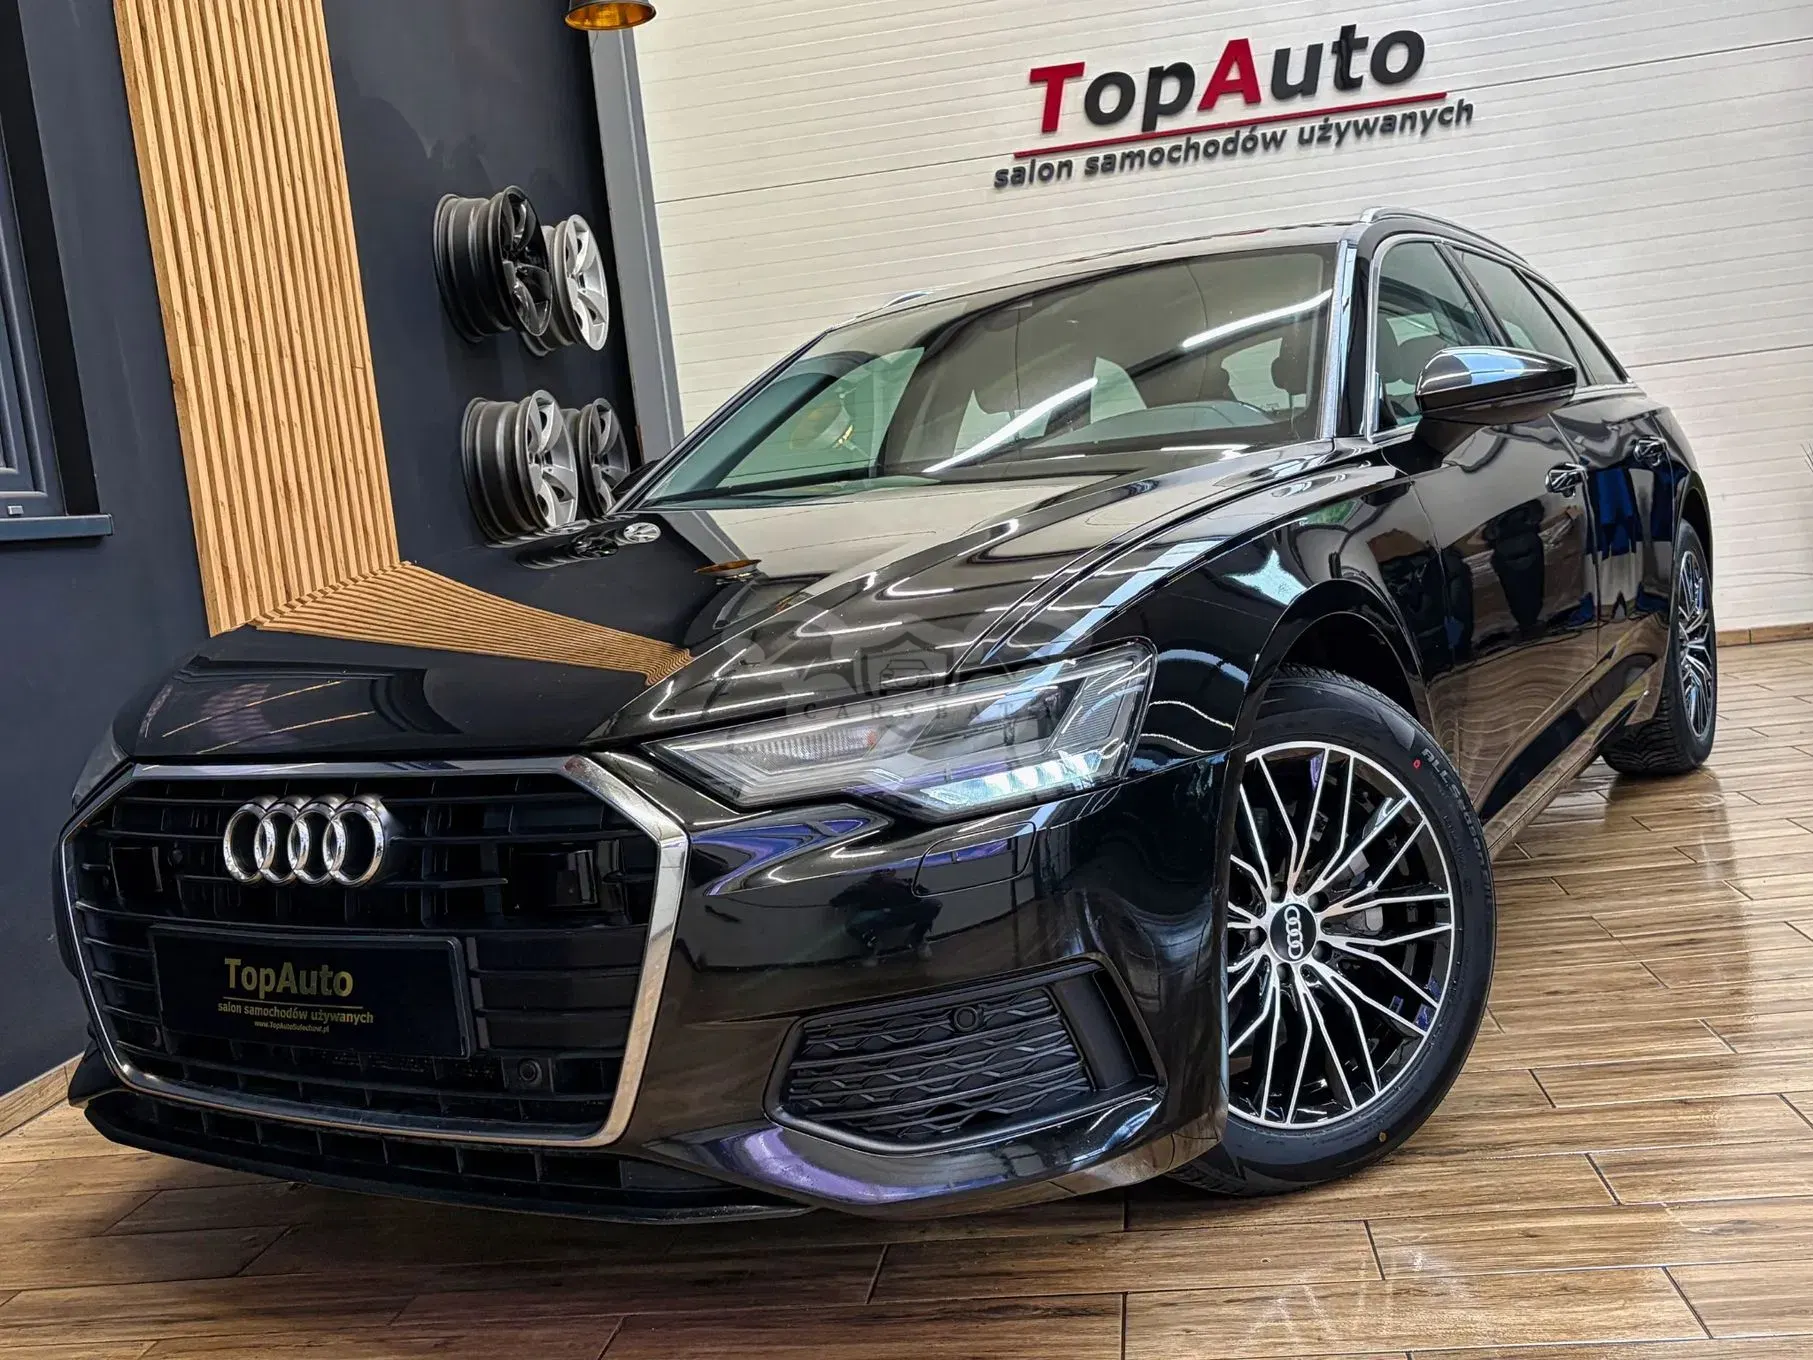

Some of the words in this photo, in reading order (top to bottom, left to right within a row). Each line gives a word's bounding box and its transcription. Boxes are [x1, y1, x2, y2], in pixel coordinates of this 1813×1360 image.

[1029, 24, 1425, 134] TopAuto
[994, 158, 1073, 189] salon
[1084, 125, 1288, 177] samochodów
[1297, 98, 1474, 145] używanych
[224, 957, 354, 1000] TopAuto
[217, 1001, 243, 1015] salon
[243, 1002, 309, 1021] samochodów
[310, 1008, 374, 1026] używanych
